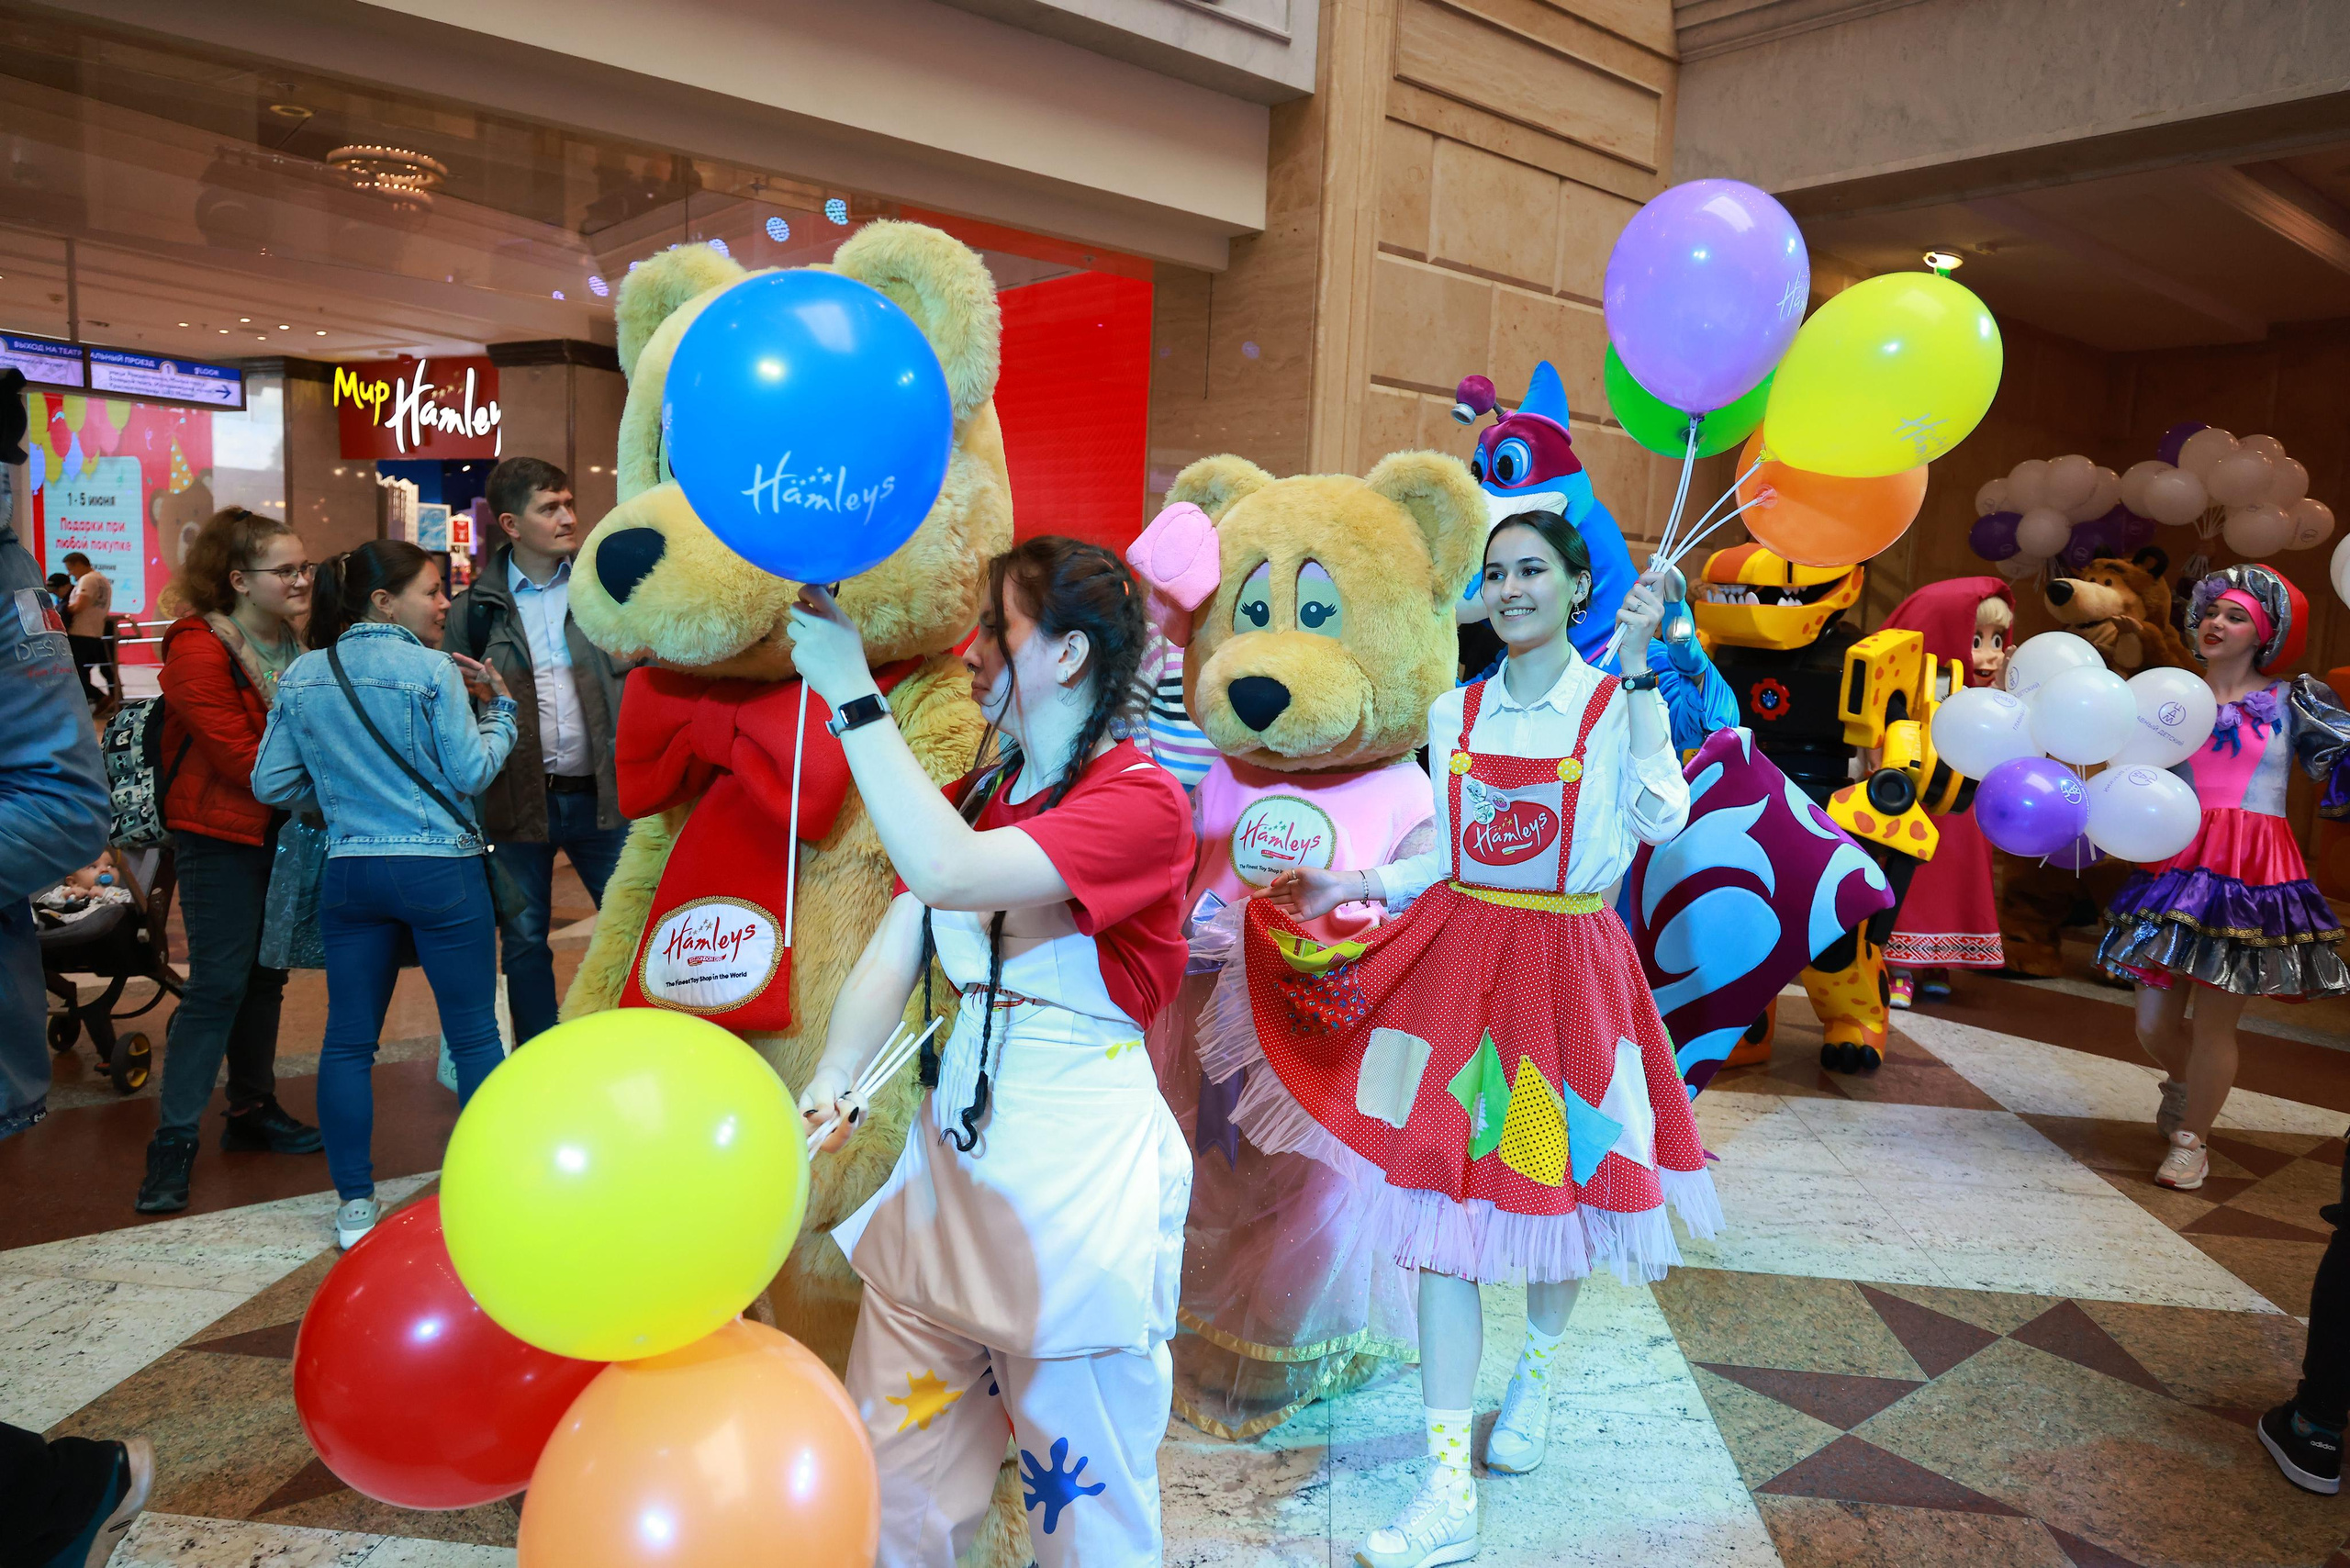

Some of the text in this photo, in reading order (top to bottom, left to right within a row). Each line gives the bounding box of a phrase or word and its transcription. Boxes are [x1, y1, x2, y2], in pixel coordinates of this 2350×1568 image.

[14, 341, 83, 356] ВЫХОД НА ТЕАТР
[741, 450, 896, 526] Hamleys
[89, 496, 117, 506] июня
[60, 517, 126, 534] Подарки при
[56, 535, 131, 553] любой покупке
[15, 639, 73, 661] DESIG
[2162, 702, 2183, 724] ЦДМ
[2157, 729, 2185, 747] ДЕТСКИЙ
[1239, 812, 1321, 865] Hamleys
[1472, 812, 1548, 857] Hamleys
[1267, 867, 1280, 875] Shop
[663, 913, 756, 965] Hamleys
[2310, 1440, 2336, 1451] adidas
